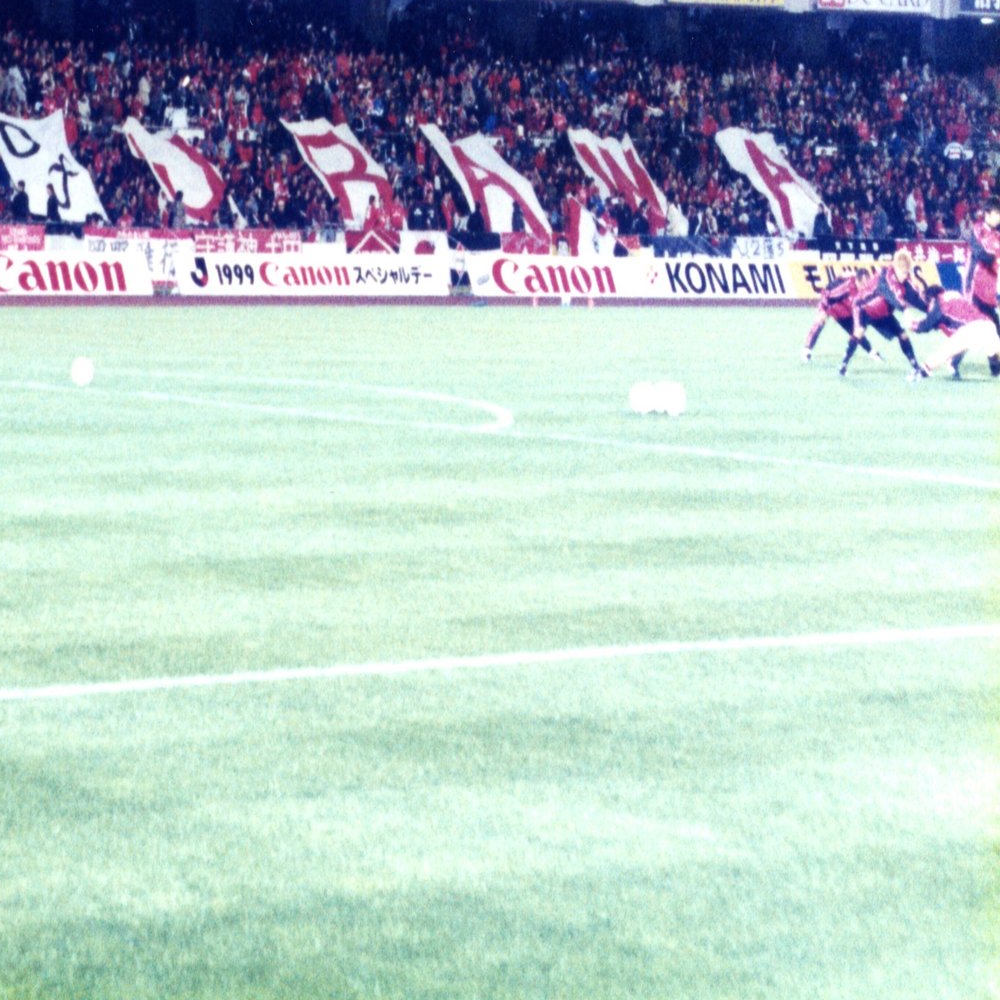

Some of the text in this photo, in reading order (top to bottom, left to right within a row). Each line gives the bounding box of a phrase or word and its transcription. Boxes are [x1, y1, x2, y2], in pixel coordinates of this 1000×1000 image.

[215, 264, 255, 285] 1999
[259, 261, 351, 287] Canon
[353, 266, 433, 285] スペシャルデー
[492, 258, 617, 295] Canon
[664, 261, 786, 295] KONAMI
